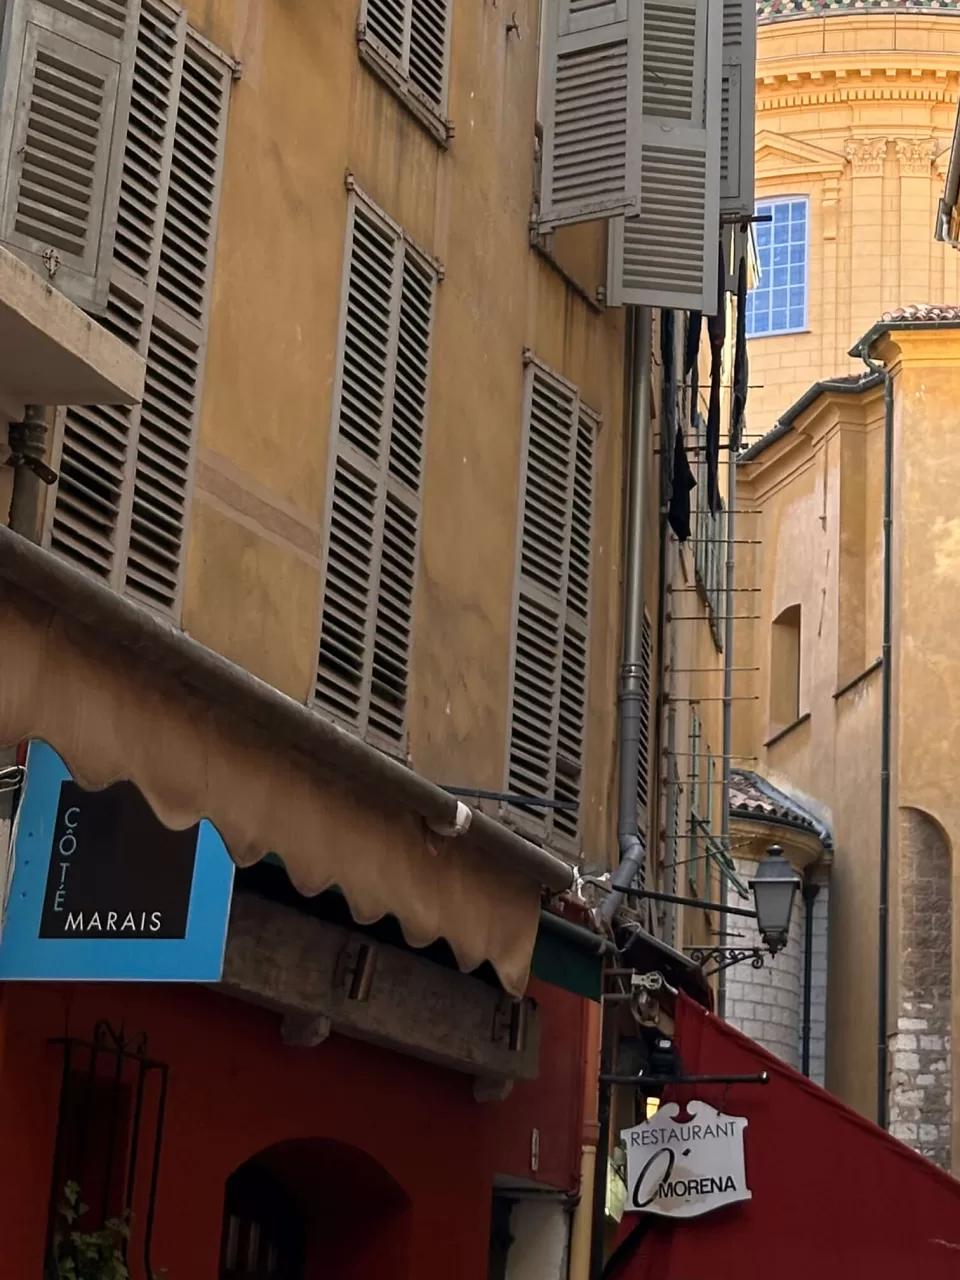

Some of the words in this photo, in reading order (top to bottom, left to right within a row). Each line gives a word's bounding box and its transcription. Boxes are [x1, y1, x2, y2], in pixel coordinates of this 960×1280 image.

[54, 807, 80, 911] CÔTÉ
[65, 911, 161, 931] MARAIS
[631, 1121, 736, 1146] RESTAURANT
